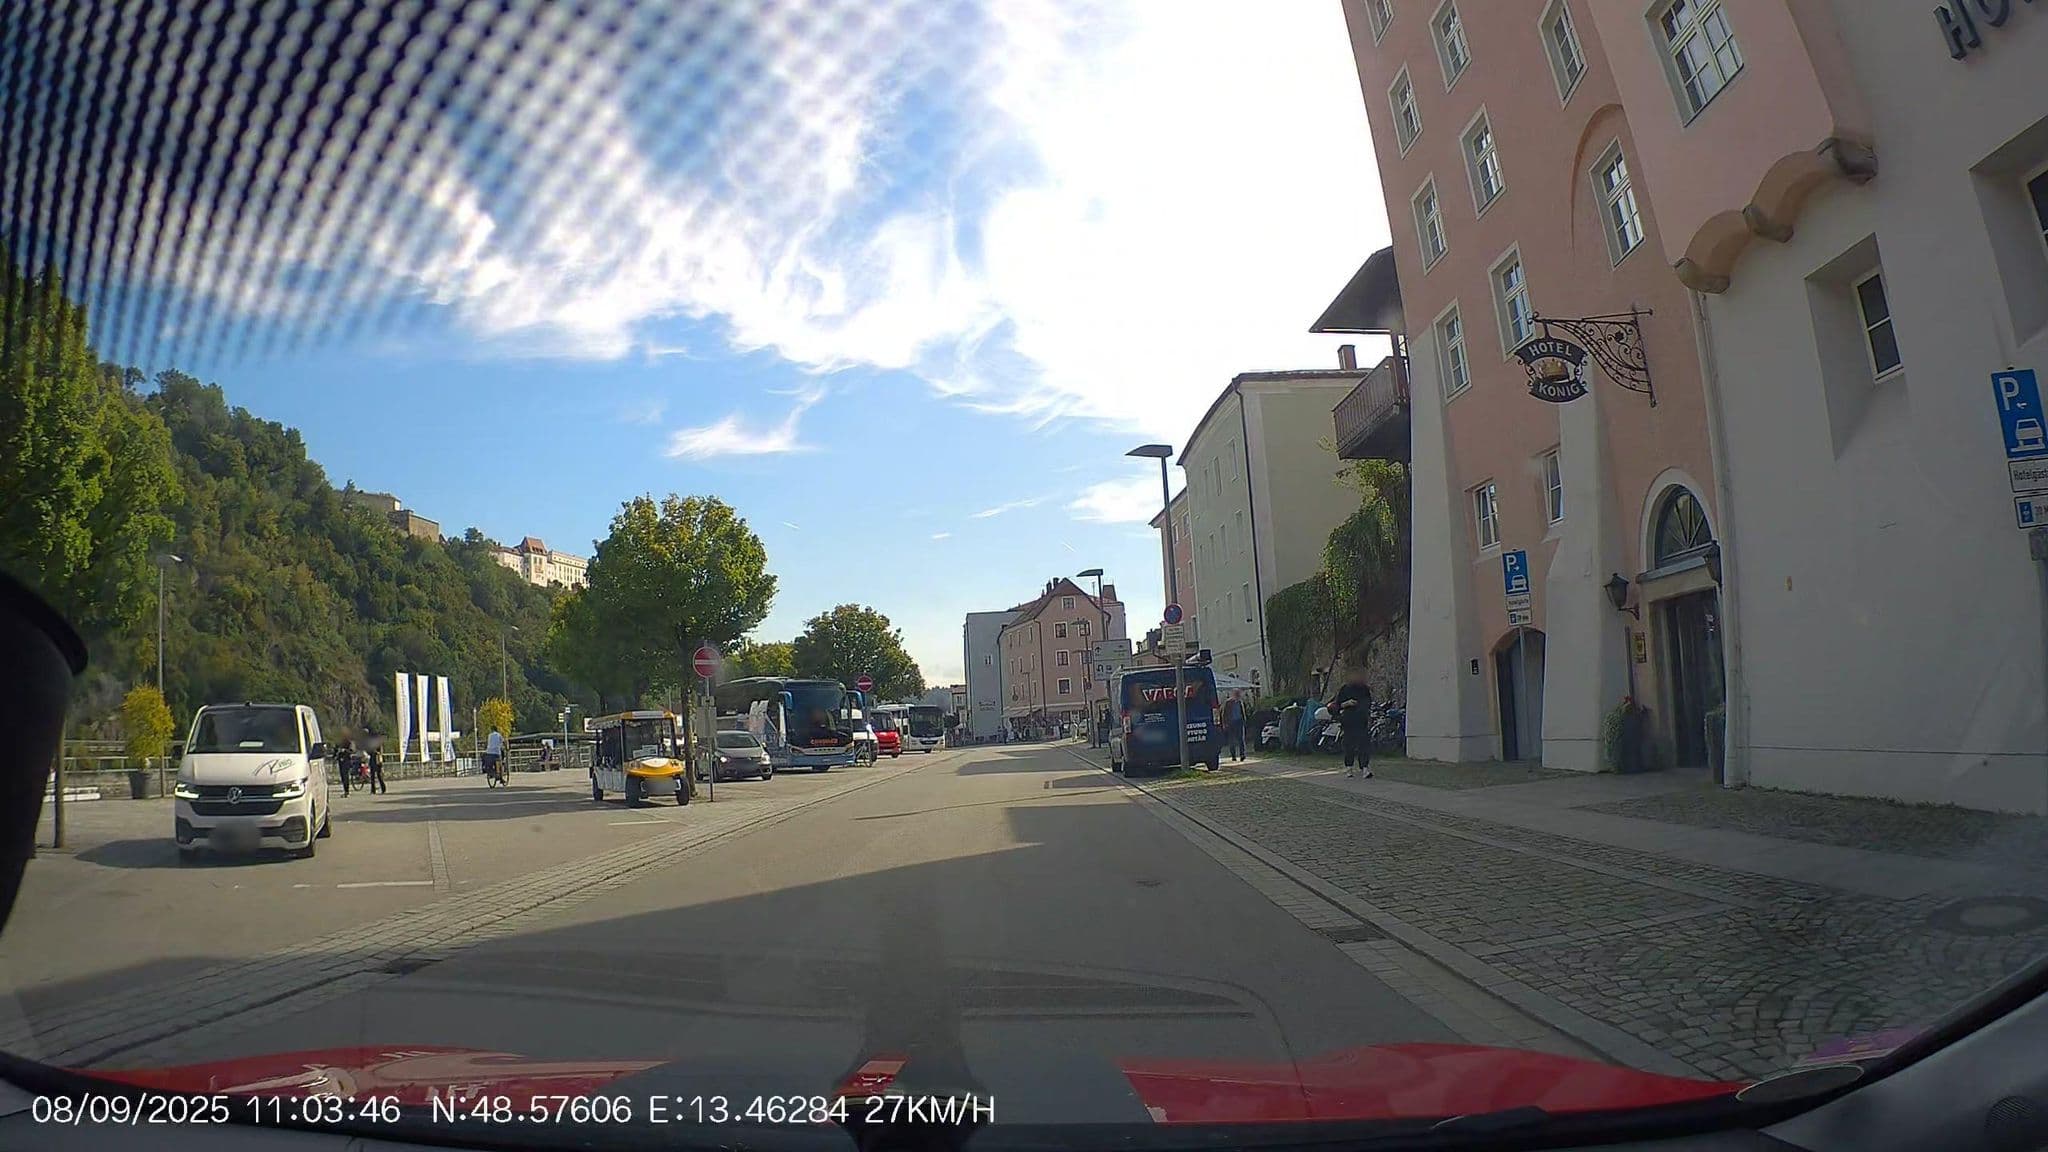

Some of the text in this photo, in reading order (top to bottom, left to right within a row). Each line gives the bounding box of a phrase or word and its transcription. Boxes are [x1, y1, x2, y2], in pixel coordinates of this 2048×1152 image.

[1528, 341, 1573, 356] HOTEL
[1999, 377, 2019, 410] P
[2014, 466, 2048, 482] Hotelgäst
[1505, 554, 1517, 572] P
